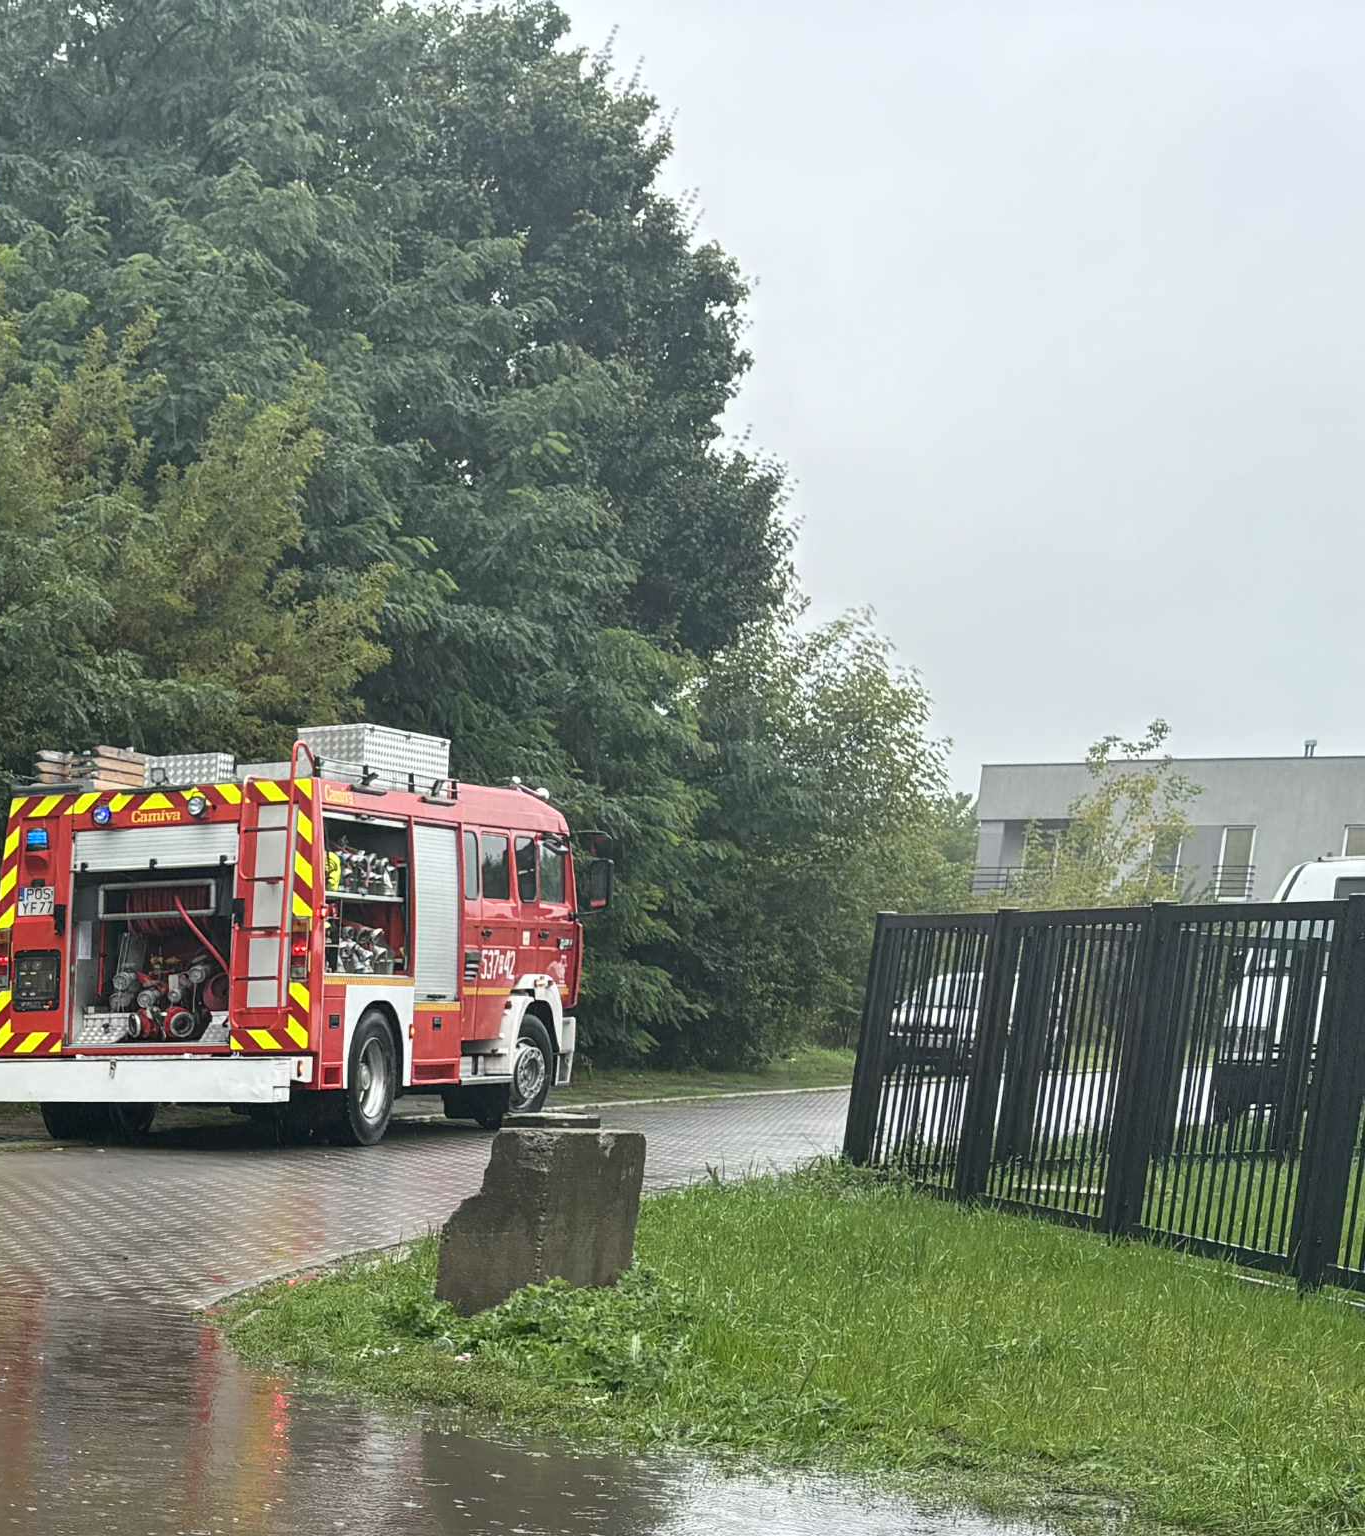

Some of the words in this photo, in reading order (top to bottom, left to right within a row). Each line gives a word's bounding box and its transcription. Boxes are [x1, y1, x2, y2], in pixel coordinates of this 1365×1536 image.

[131, 809, 181, 823] Camiva
[26, 887, 52, 900] POS
[22, 901, 53, 914] YF77
